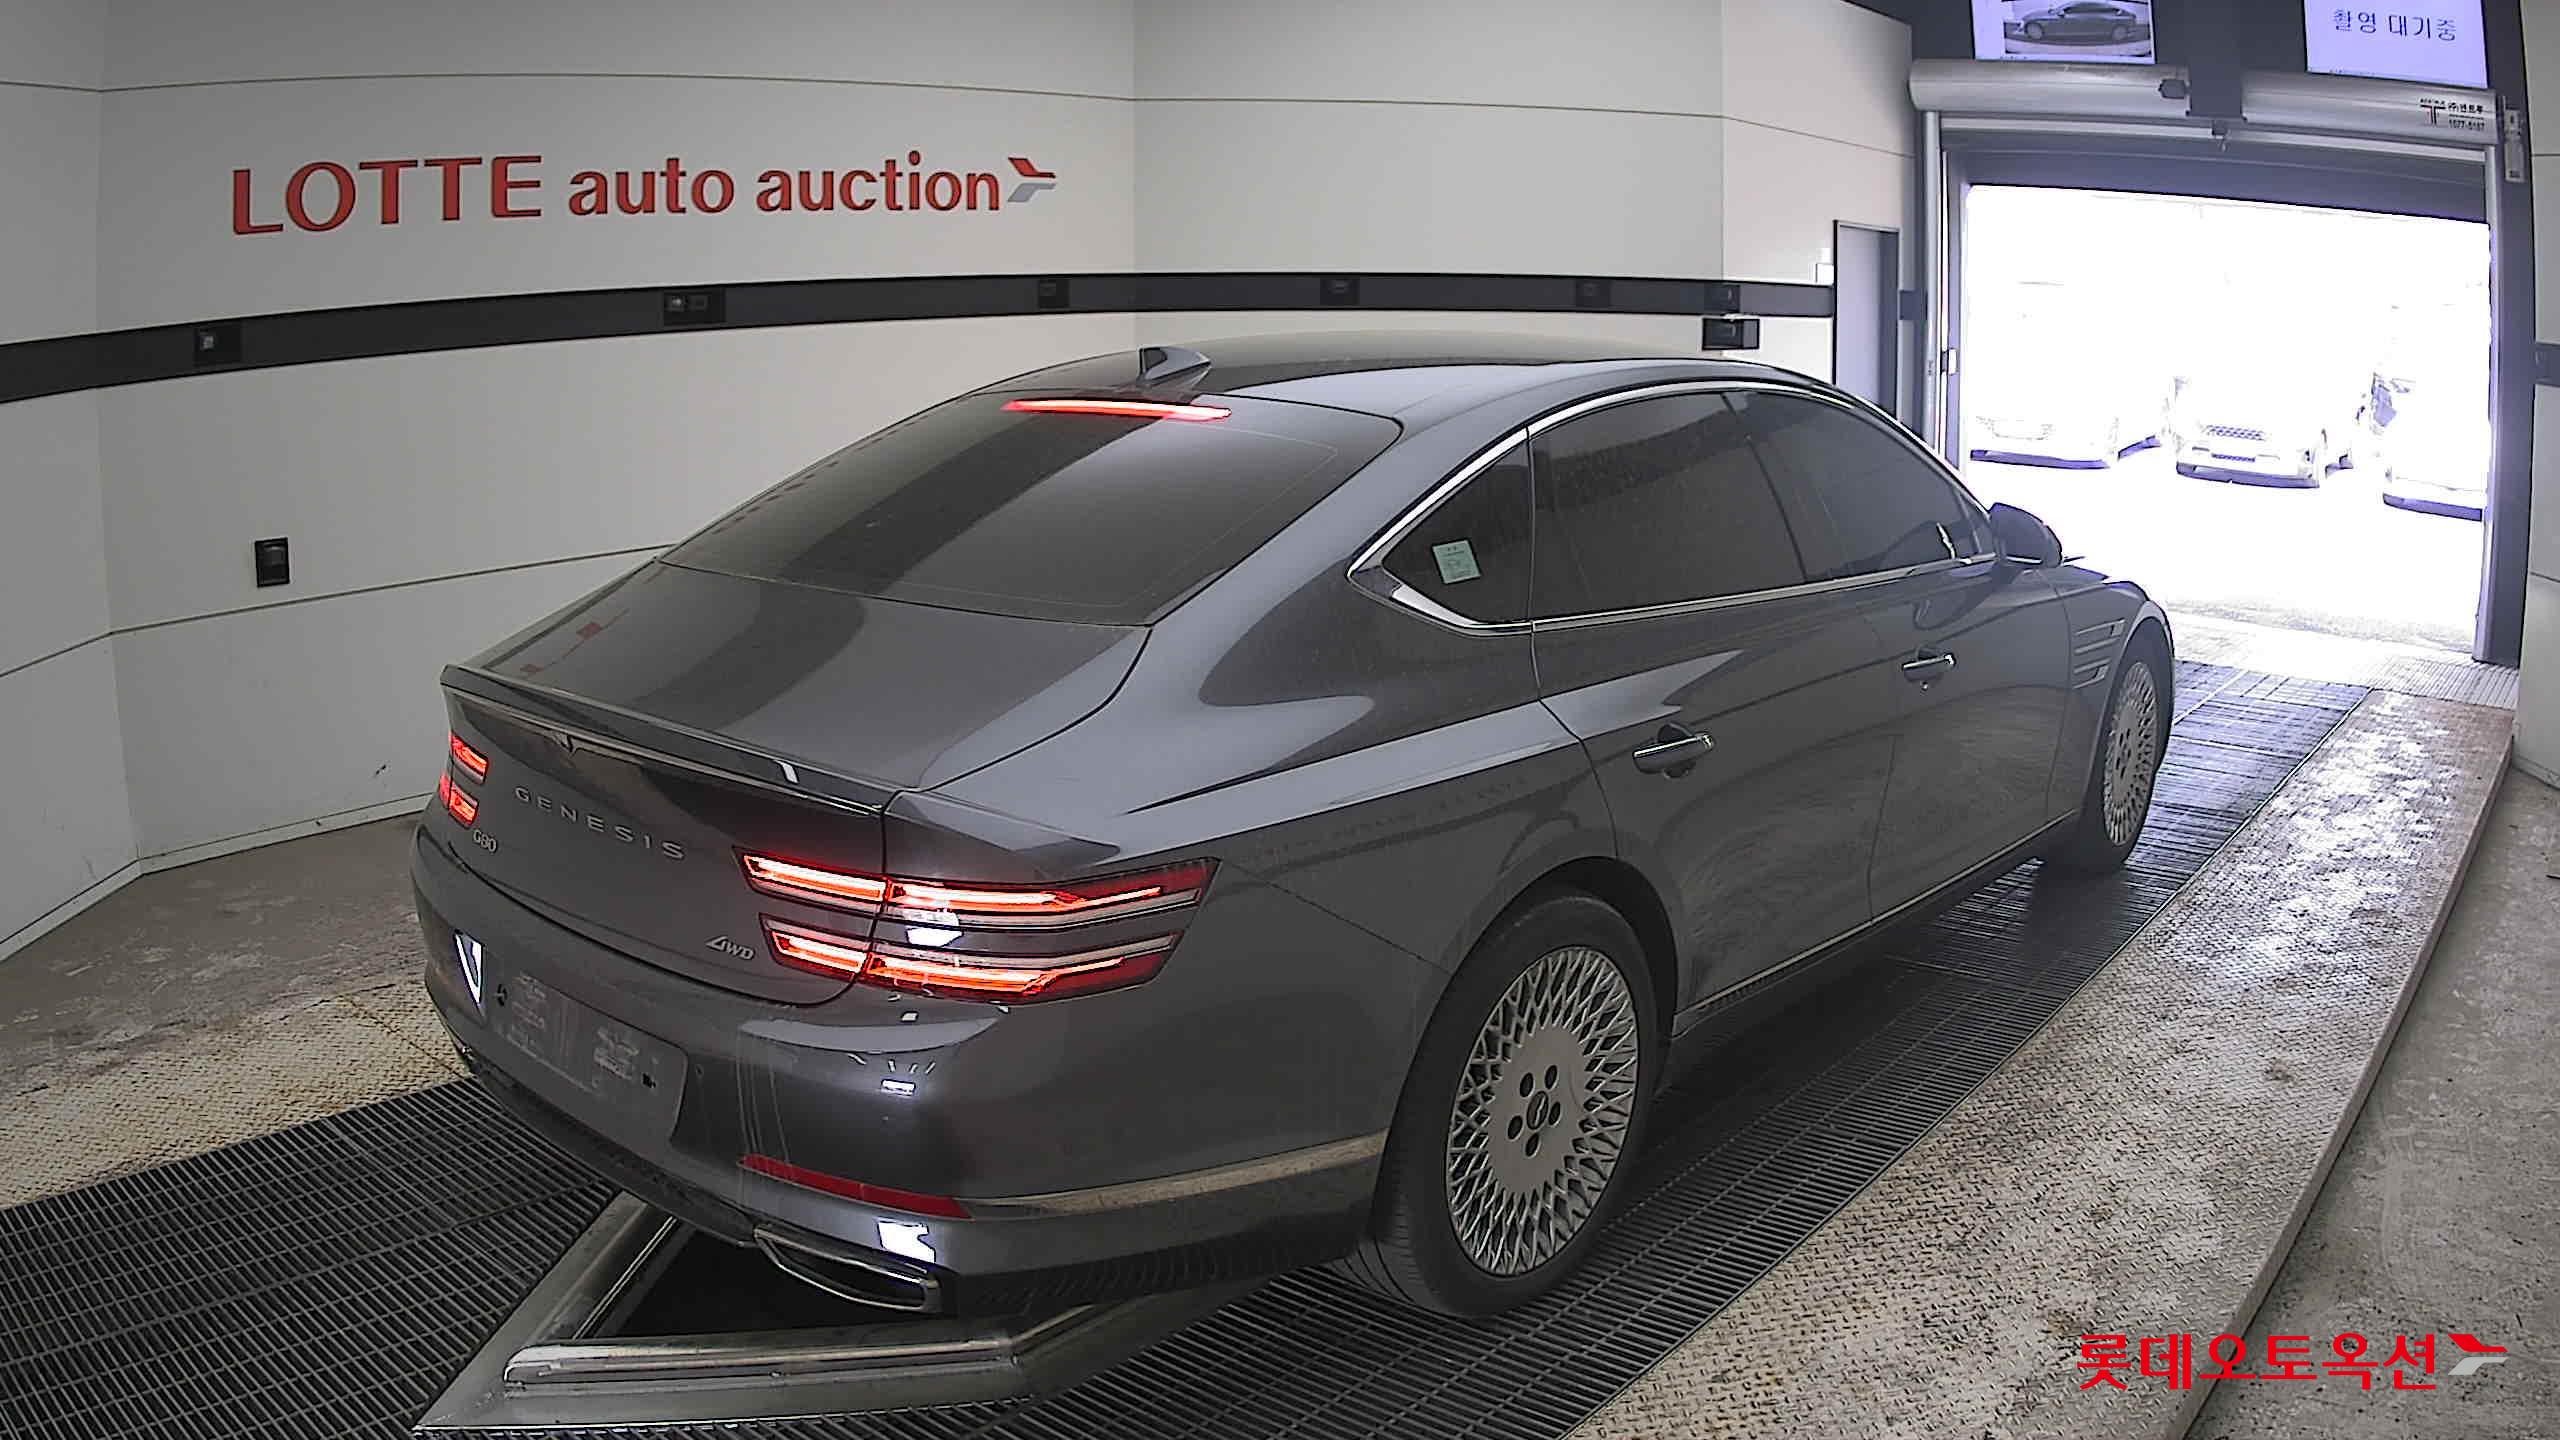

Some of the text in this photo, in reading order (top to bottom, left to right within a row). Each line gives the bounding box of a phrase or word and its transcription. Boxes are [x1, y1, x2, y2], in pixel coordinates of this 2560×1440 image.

[2388, 14, 2456, 42] 대기중
[232, 150, 1001, 236] LOTTE auto auction
[472, 828, 498, 854] G80
[514, 786, 685, 860] GENESIS
